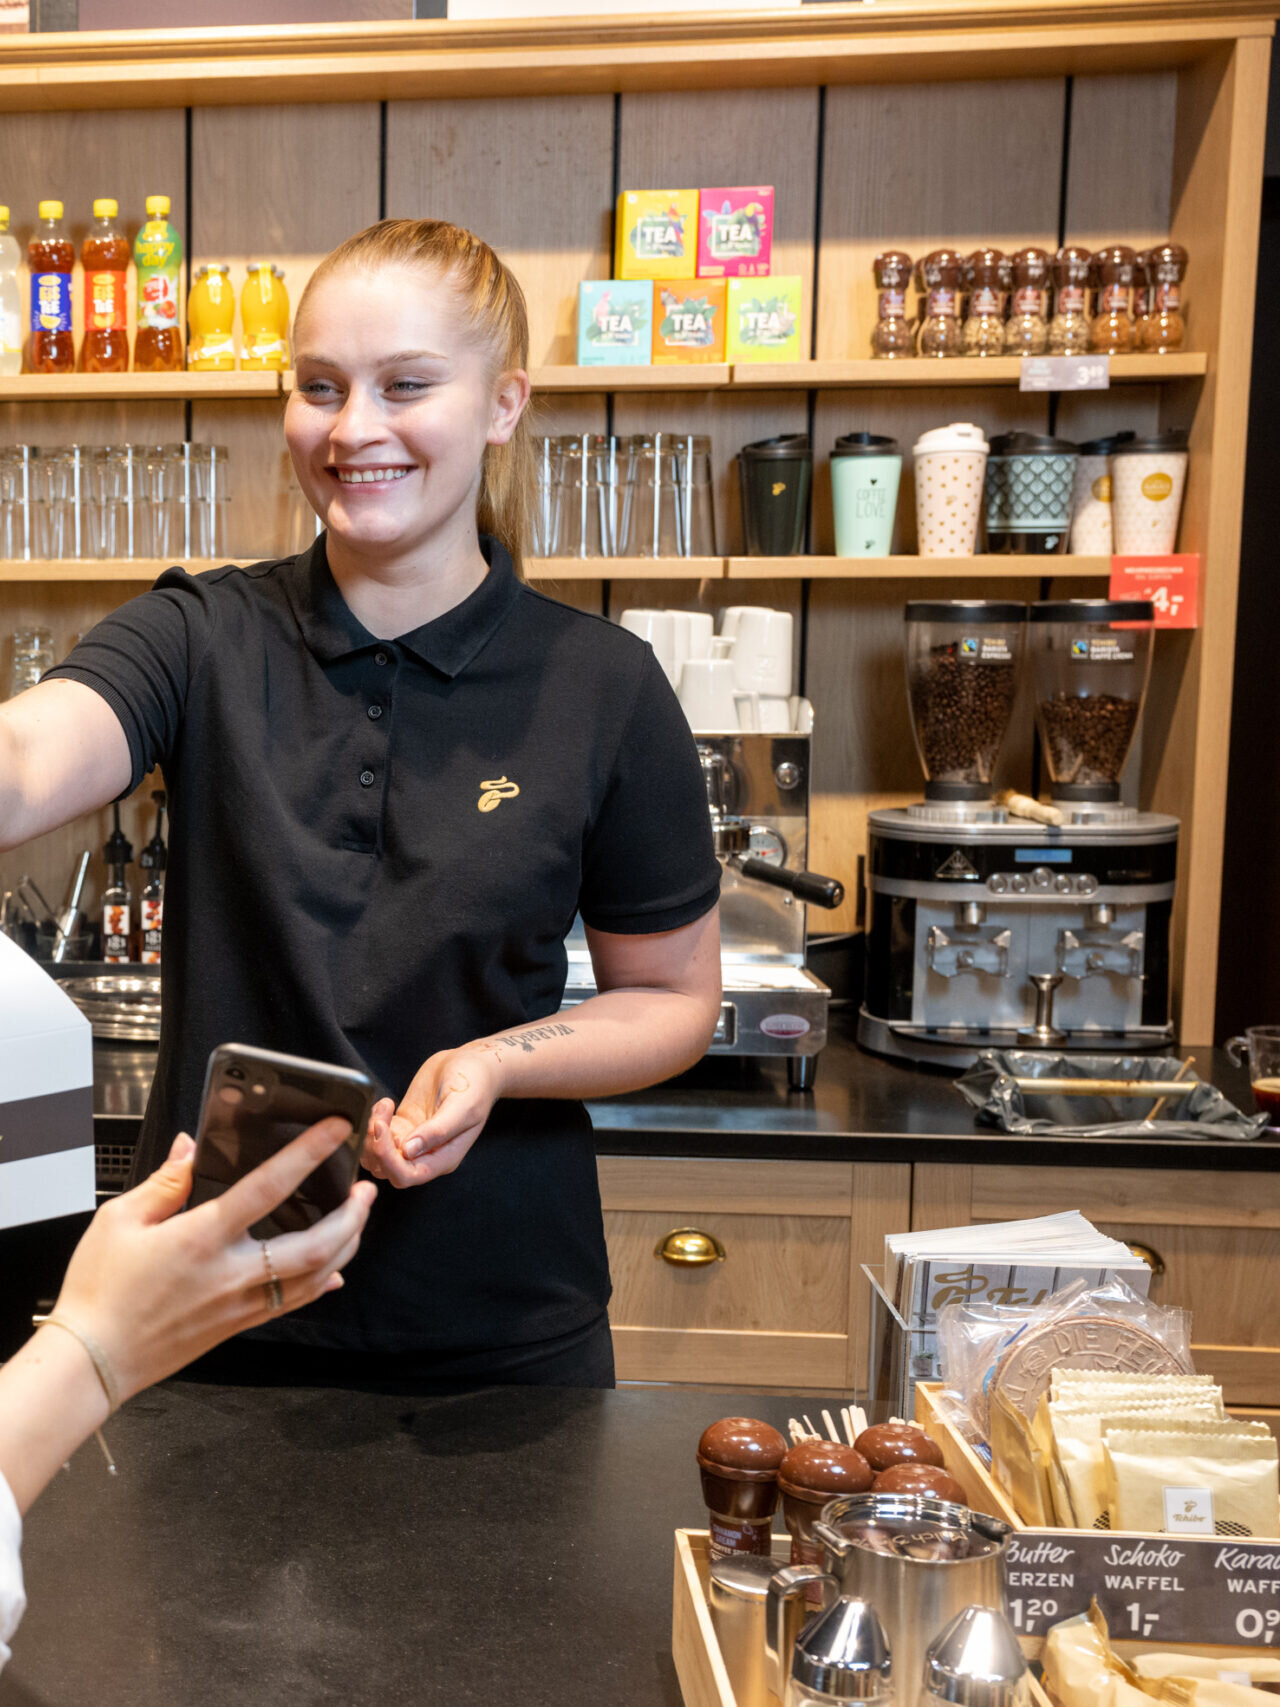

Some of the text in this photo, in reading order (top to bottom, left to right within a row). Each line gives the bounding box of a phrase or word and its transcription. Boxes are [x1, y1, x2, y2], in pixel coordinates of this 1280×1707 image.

[643, 225, 677, 243] TEA
[719, 223, 753, 242] TEA
[599, 314, 632, 332] TEA
[671, 313, 707, 331] TEA
[746, 312, 781, 331] TEA
[855, 502, 886, 519] LOVE
[1006, 1540, 1075, 1565] Butter
[1103, 1541, 1185, 1568] Schoko
[1104, 1575, 1185, 1592] WAFFEL
[1126, 1602, 1160, 1636] 1,-
